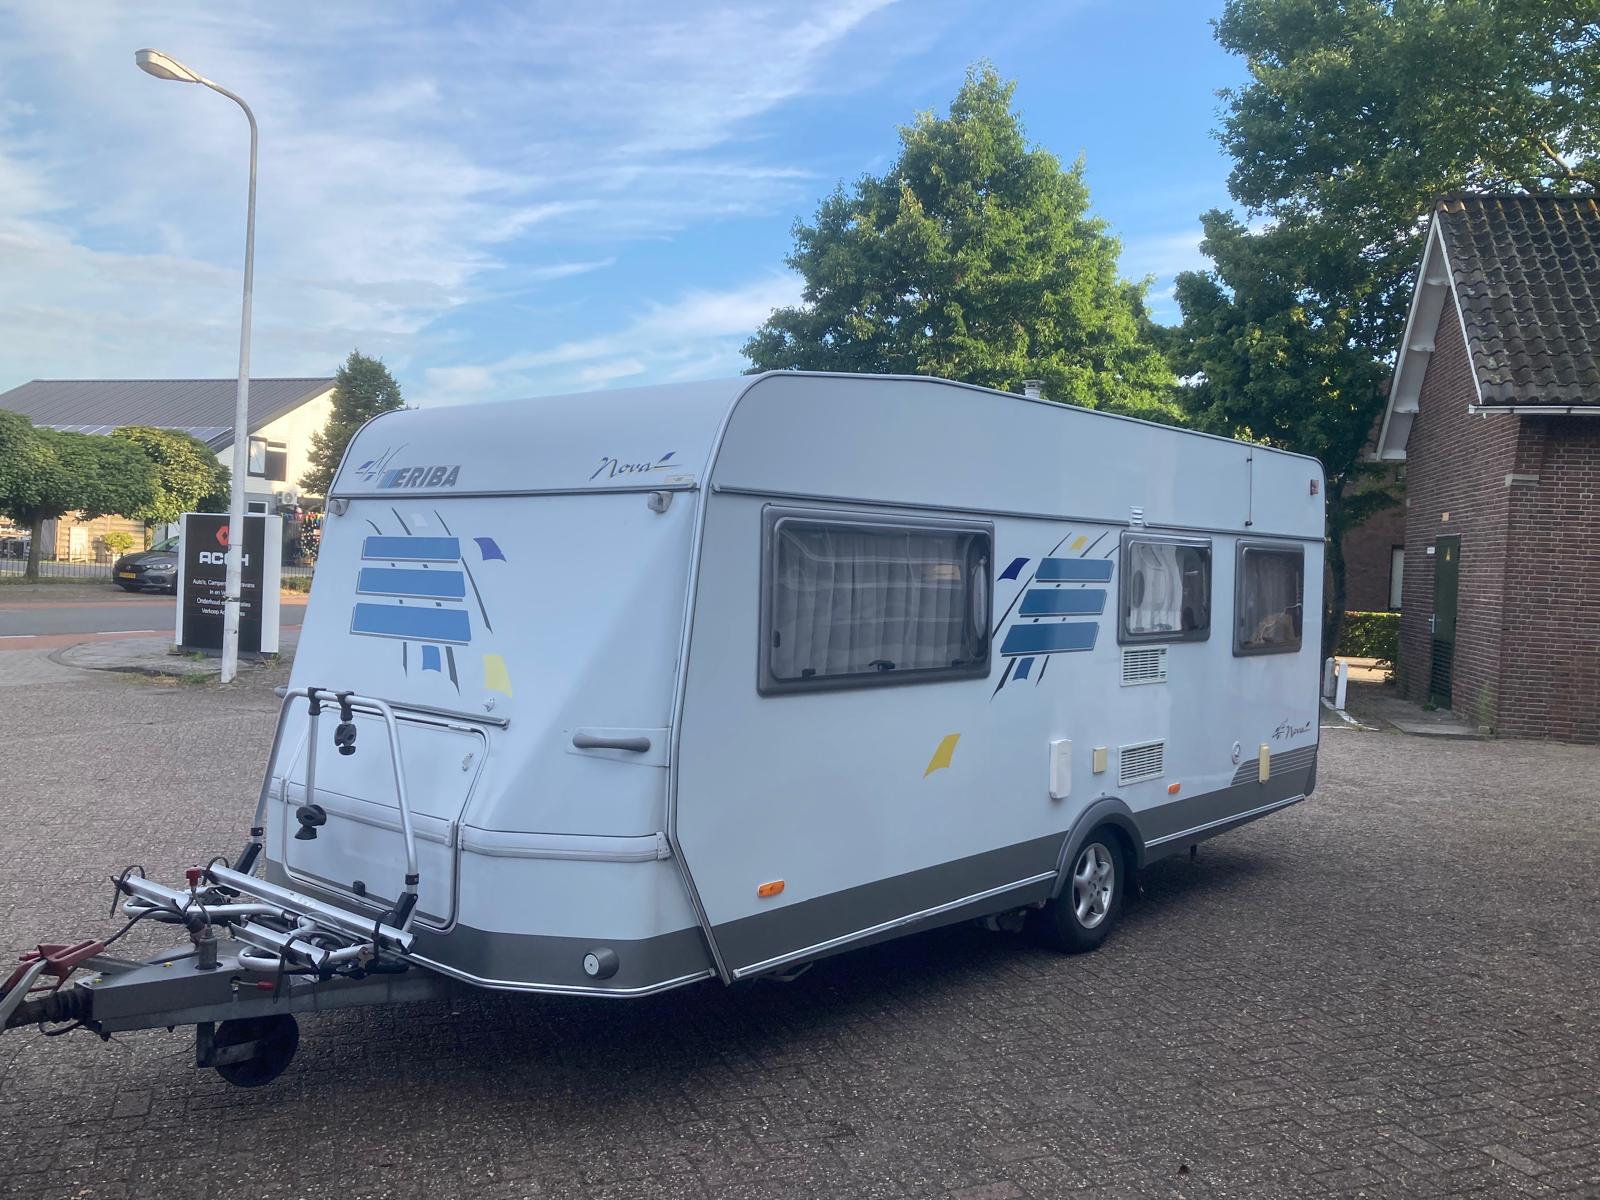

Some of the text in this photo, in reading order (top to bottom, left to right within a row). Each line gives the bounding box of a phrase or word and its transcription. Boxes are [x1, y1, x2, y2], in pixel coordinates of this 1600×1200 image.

[393, 465, 461, 489] ERIBA
[589, 455, 660, 480] Nova
[197, 597, 220, 605] Onderhoud
